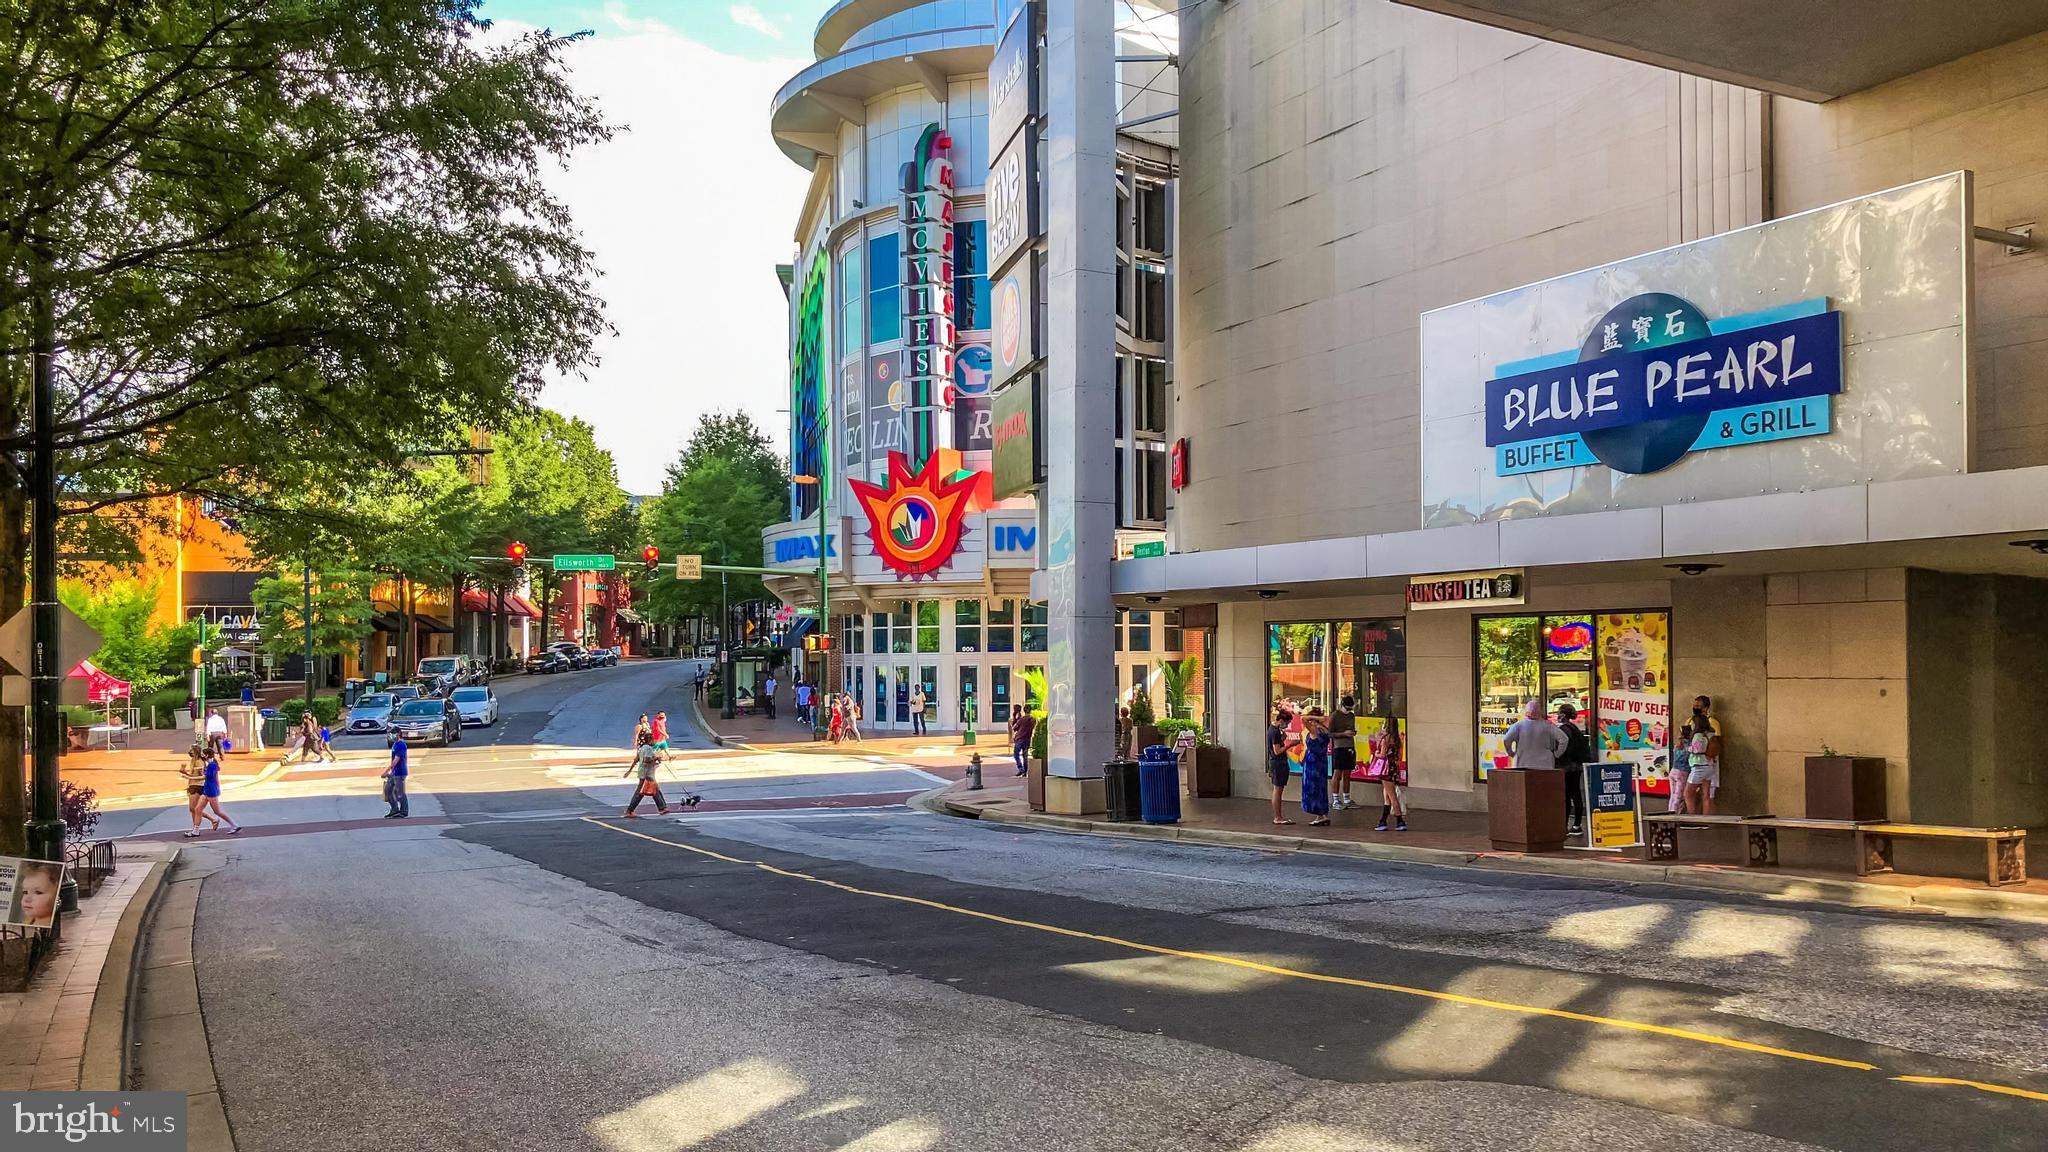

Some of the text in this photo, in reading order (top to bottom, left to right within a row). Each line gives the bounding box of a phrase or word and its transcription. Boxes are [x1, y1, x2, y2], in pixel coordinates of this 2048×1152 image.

[912, 200, 929, 372] MOVIES
[1503, 335, 1812, 431] BLUE PEARL
[1504, 404, 1816, 469] BUFFET & GRILL
[995, 526, 1036, 551] IM
[558, 559, 594, 567] Ellsworth
[222, 615, 260, 629] CAVA
[1364, 653, 1380, 665] TEA
[1600, 697, 1625, 711] TREAT
[1645, 702, 1670, 716] SELF!
[1481, 717, 1505, 725] HEALTHY
